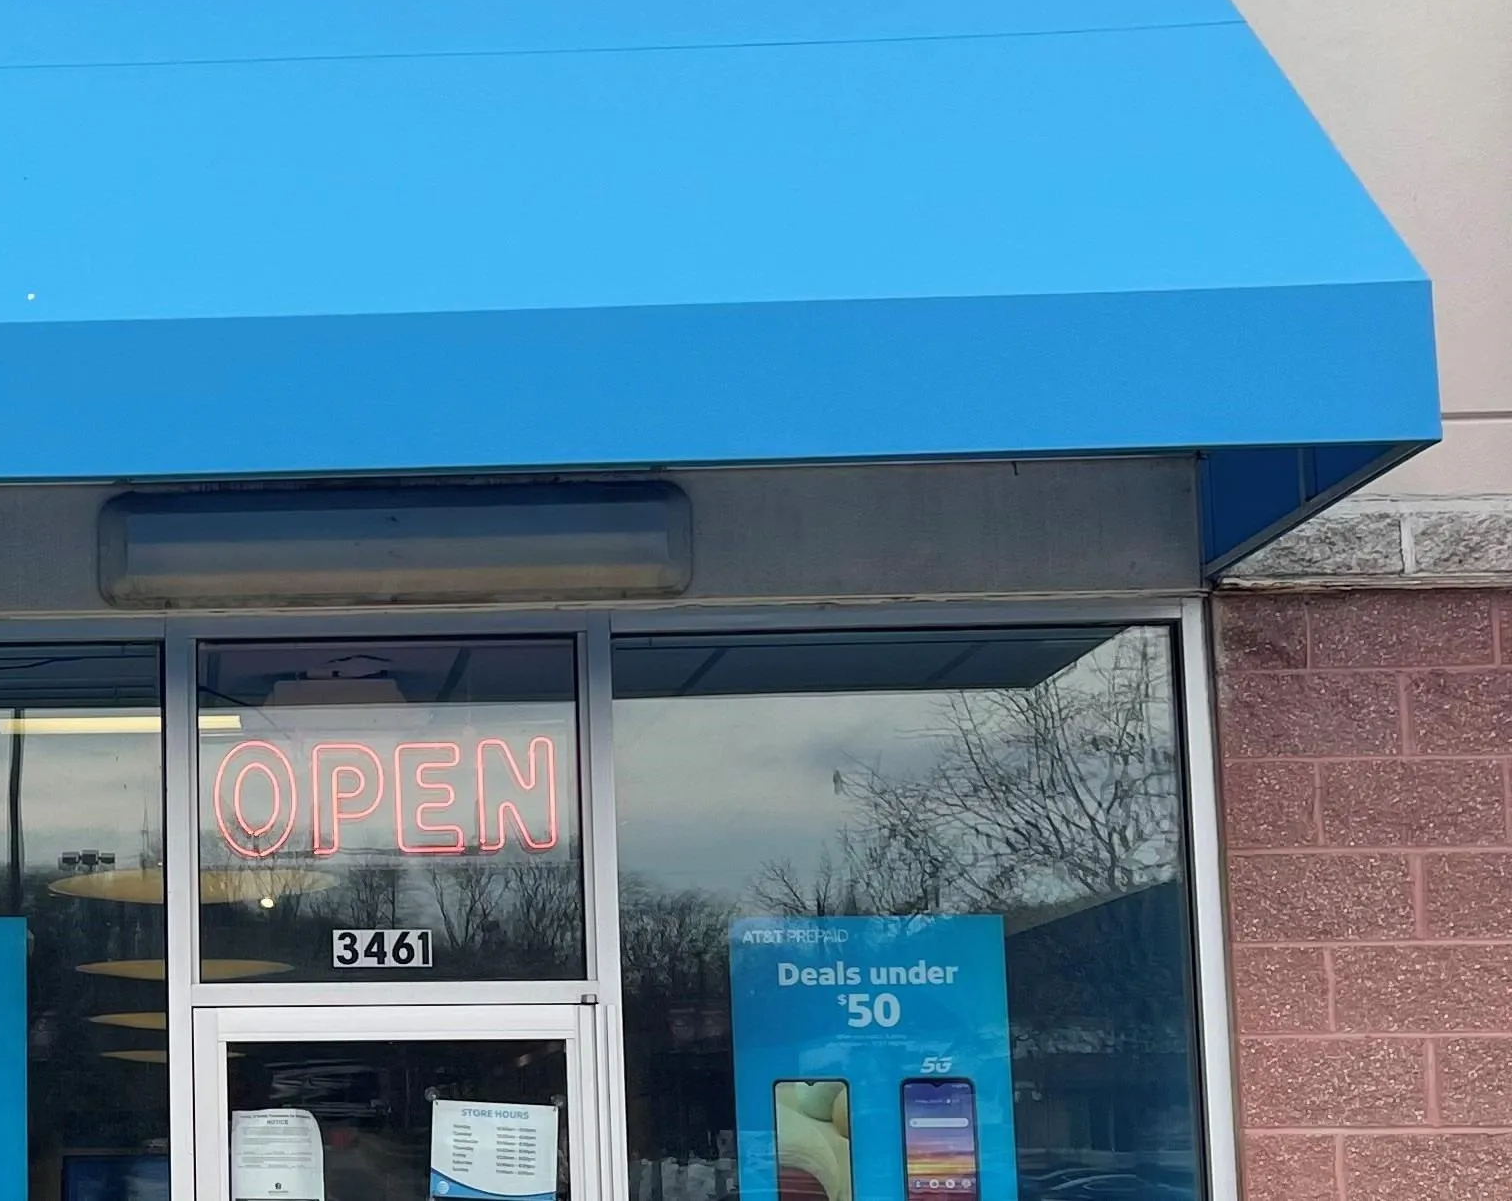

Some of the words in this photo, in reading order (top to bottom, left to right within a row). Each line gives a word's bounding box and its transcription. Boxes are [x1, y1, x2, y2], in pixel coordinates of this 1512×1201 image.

[214, 736, 558, 857] OPEN
[336, 932, 431, 965] 3461
[743, 929, 784, 944] AT&T
[787, 929, 849, 943] PREPAID
[777, 961, 862, 986] Deals
[870, 960, 959, 985] under
[837, 993, 901, 1028] $50
[920, 1057, 952, 1073] 5G
[462, 1108, 493, 1118] STORE
[495, 1109, 530, 1120] HOURS
